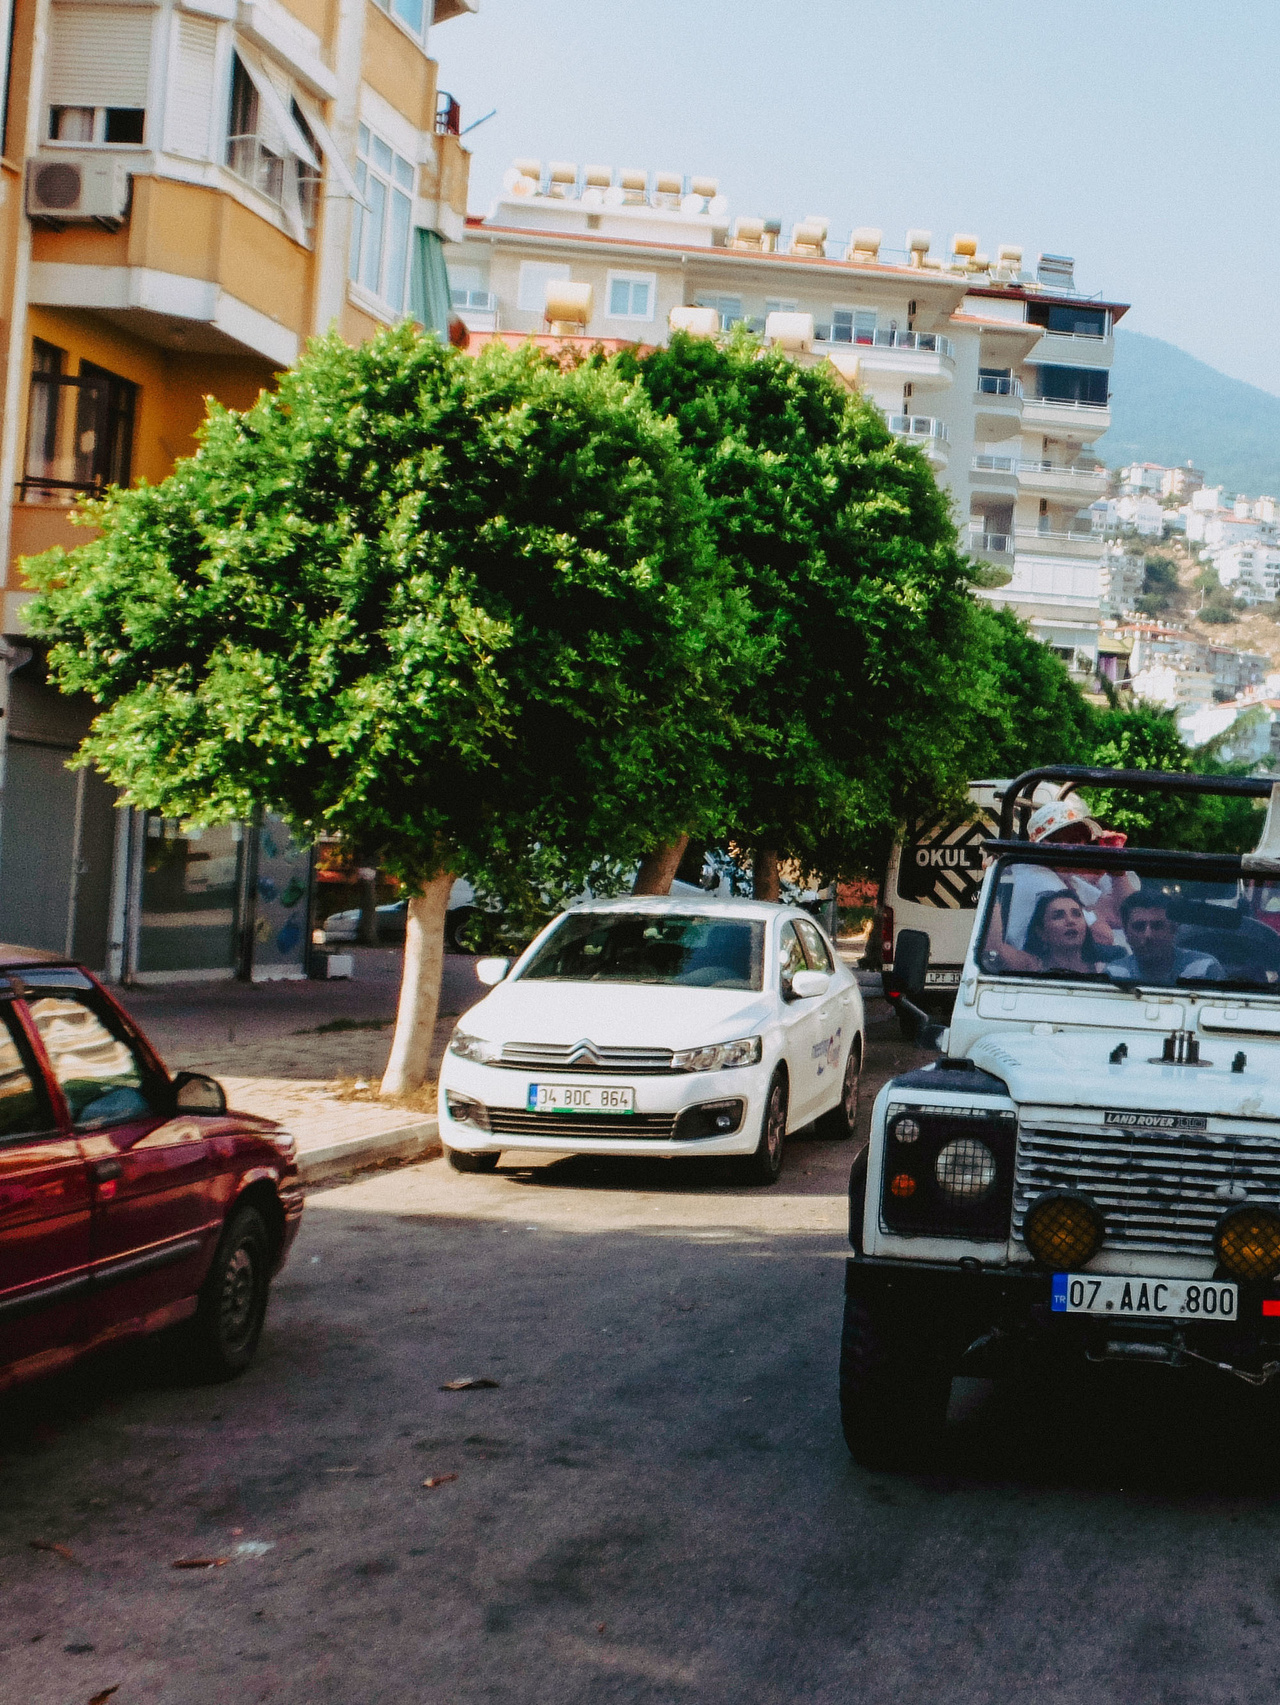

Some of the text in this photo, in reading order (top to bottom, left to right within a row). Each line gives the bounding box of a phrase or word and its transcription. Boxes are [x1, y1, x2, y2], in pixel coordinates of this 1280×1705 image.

[915, 848, 971, 867] OKUL
[600, 1090, 628, 1108] 864
[1106, 1113, 1136, 1125] LAND
[1136, 1115, 1174, 1127] ROVER
[1069, 1280, 1234, 1316] 07 AAC 800
